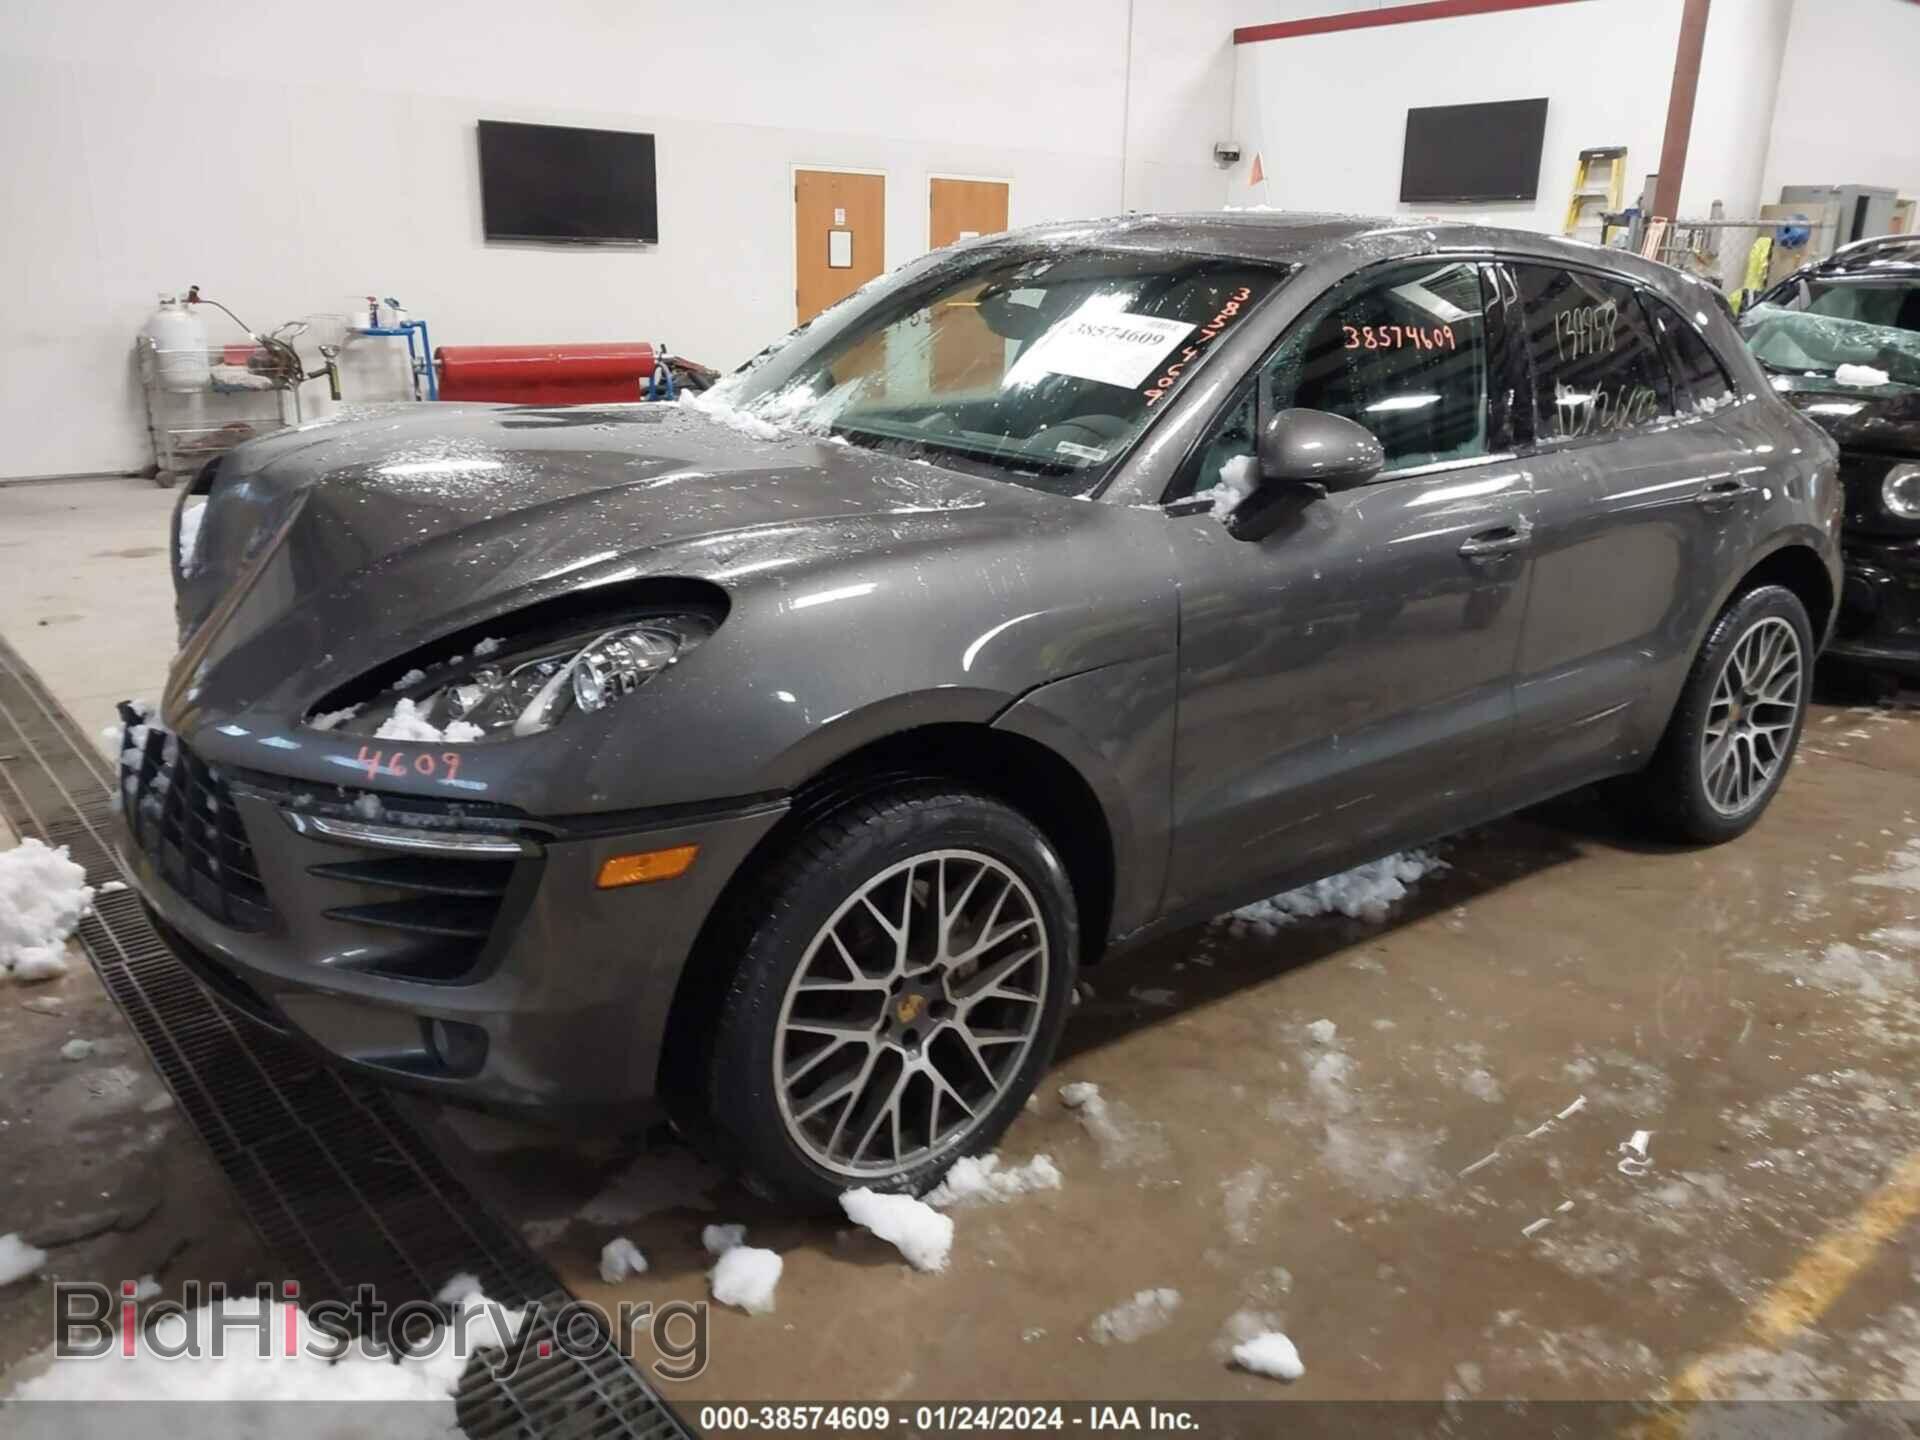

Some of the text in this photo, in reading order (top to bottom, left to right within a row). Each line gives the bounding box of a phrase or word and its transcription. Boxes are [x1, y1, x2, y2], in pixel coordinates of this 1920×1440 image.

[1077, 322, 1166, 346] 38574609
[1143, 286, 1252, 407] 38574609
[1342, 325, 1456, 350] 38574609
[357, 745, 461, 783] 4609
